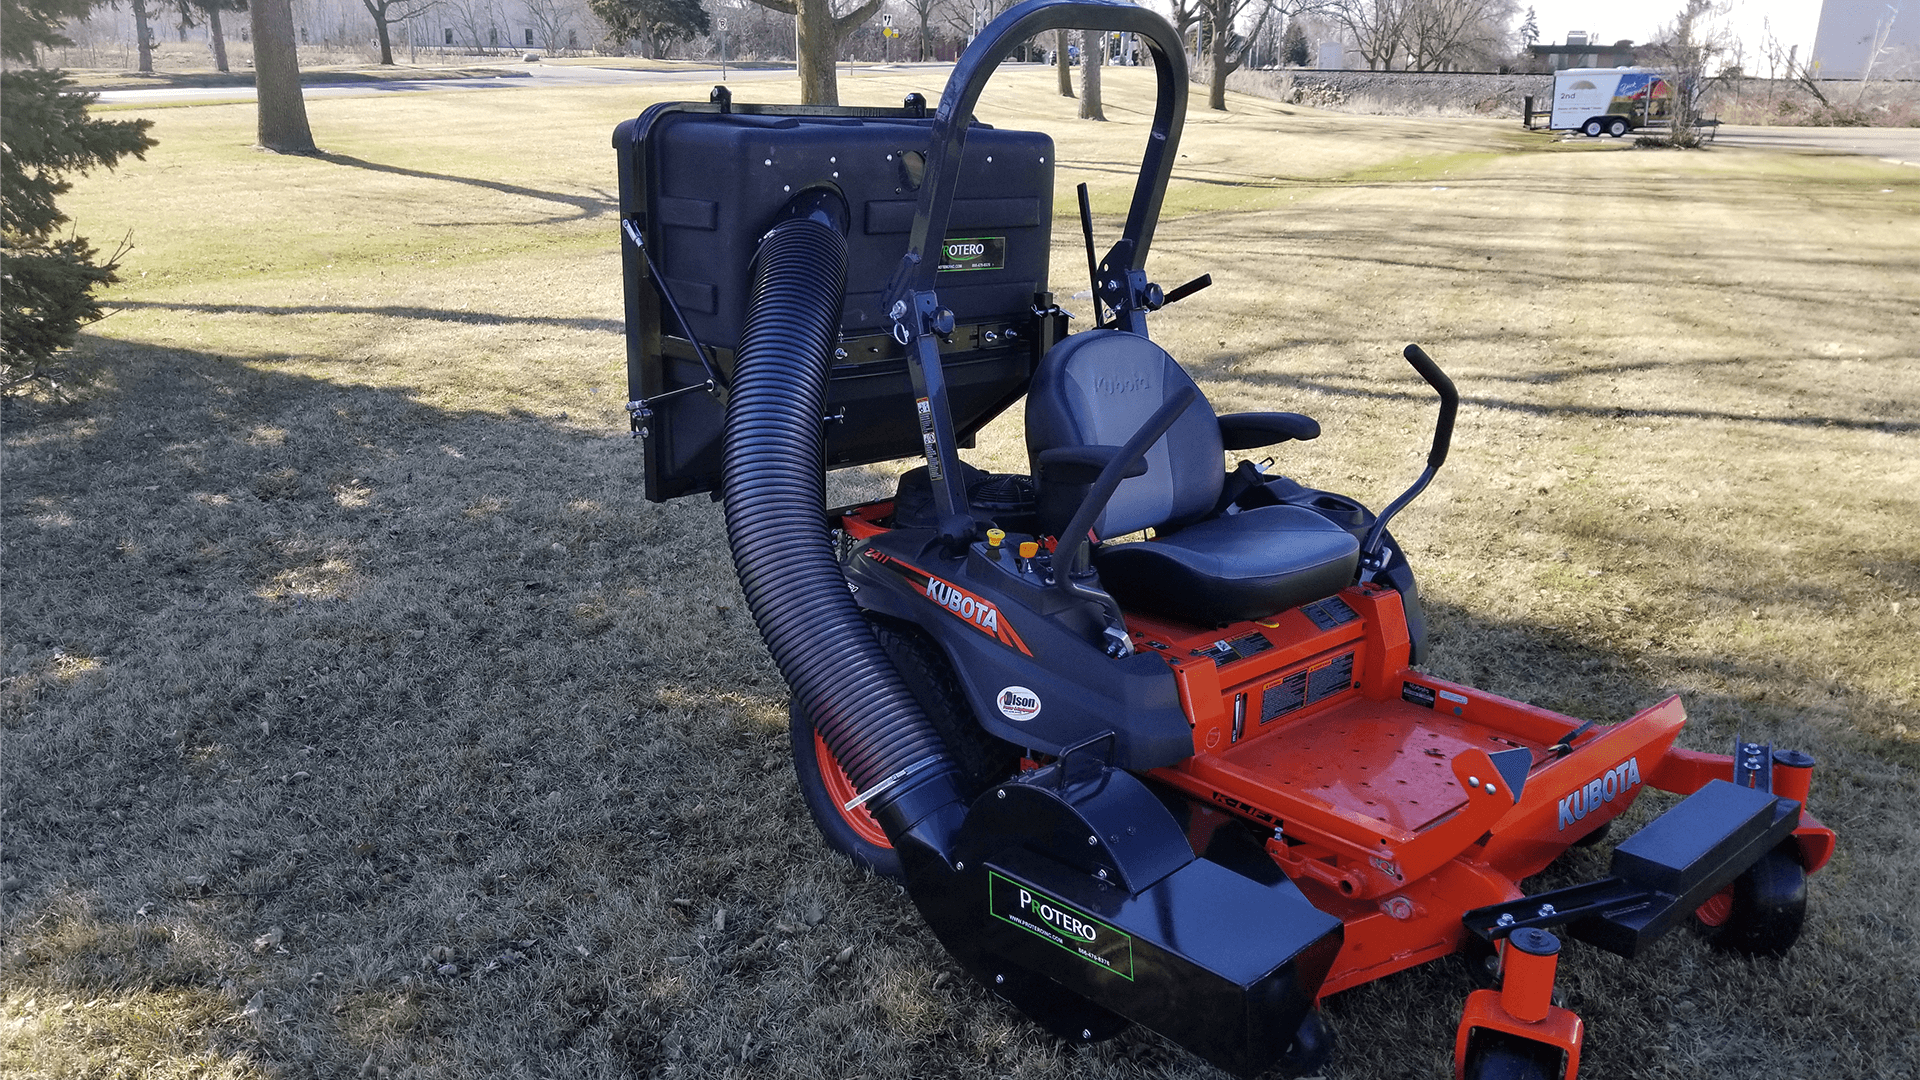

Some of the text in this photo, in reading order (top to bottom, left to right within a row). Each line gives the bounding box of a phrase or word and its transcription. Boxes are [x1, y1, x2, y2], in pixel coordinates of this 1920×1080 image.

[943, 243, 985, 258] ROTERO
[926, 576, 998, 632] KUBOTA
[1003, 691, 1036, 708] Olson
[1558, 756, 1641, 831] KUBOTA
[1020, 888, 1097, 942] PROTERO
